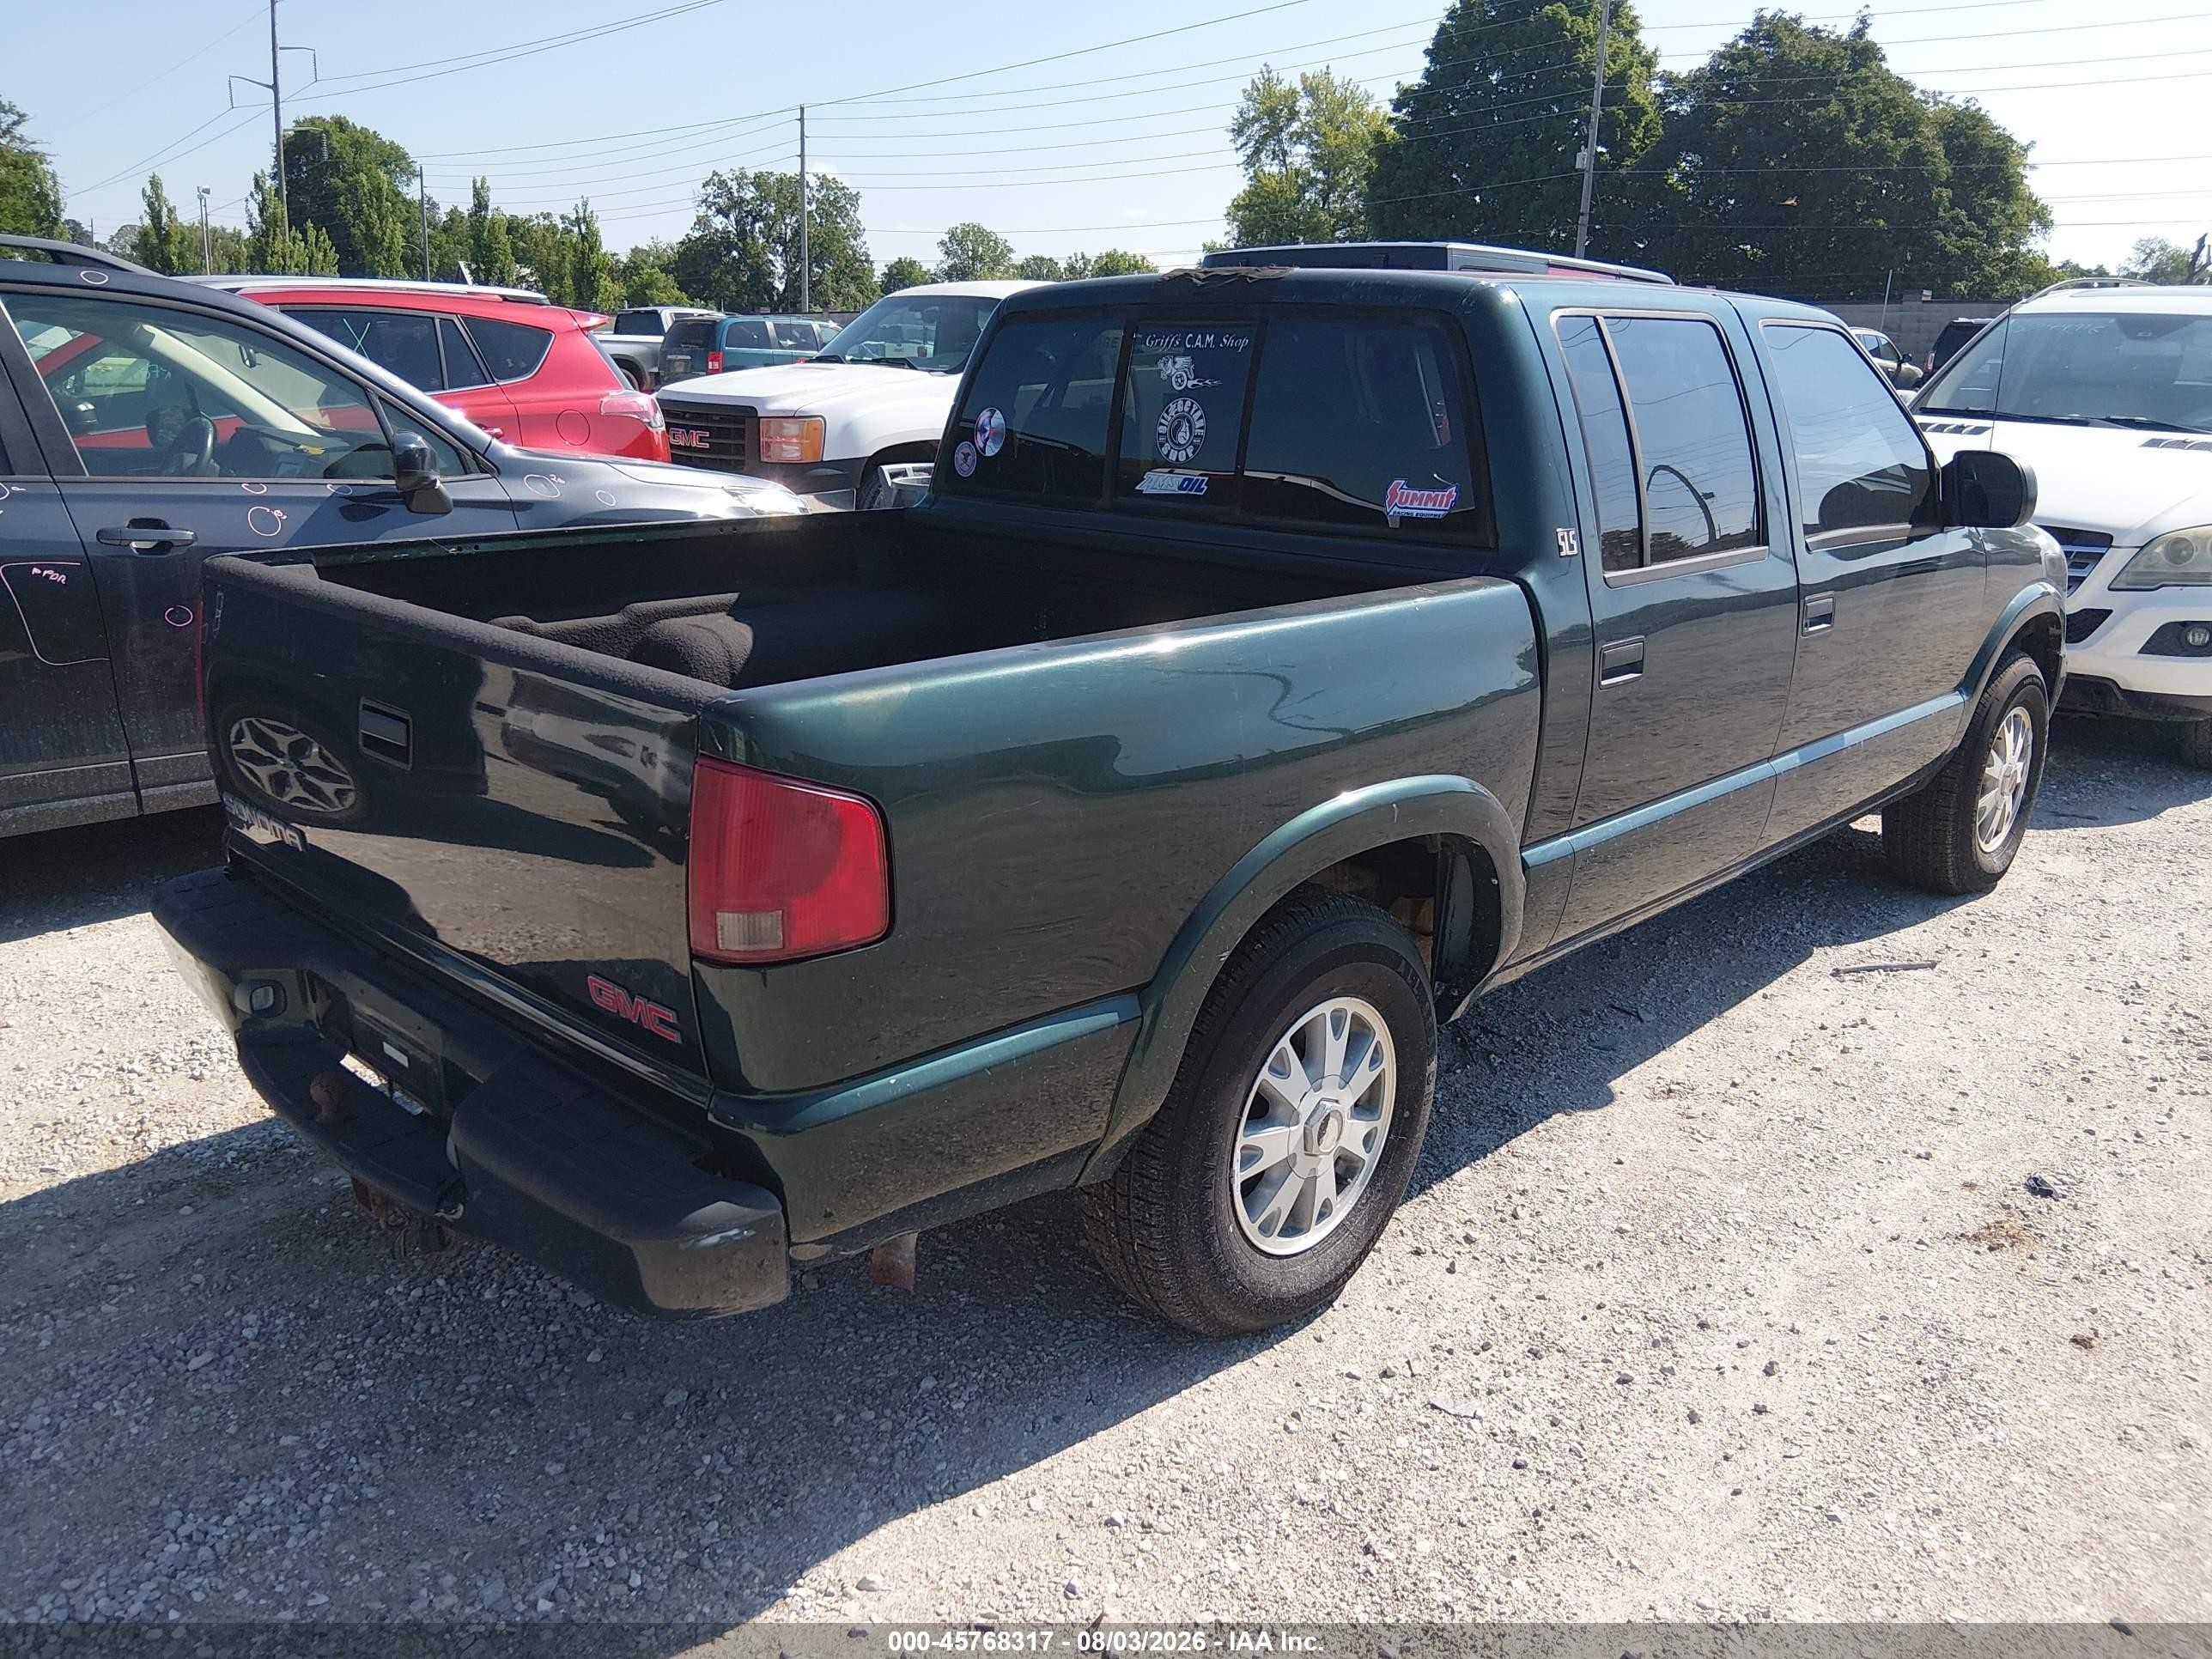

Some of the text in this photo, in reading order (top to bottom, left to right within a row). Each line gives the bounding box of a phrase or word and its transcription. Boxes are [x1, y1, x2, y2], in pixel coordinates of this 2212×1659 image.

[1186, 333, 1215, 348] C.A.M.
[1219, 334, 1249, 352] Shop
[670, 428, 710, 448] GMC
[1556, 528, 1578, 556] SLS
[587, 975, 682, 1044] GMC
